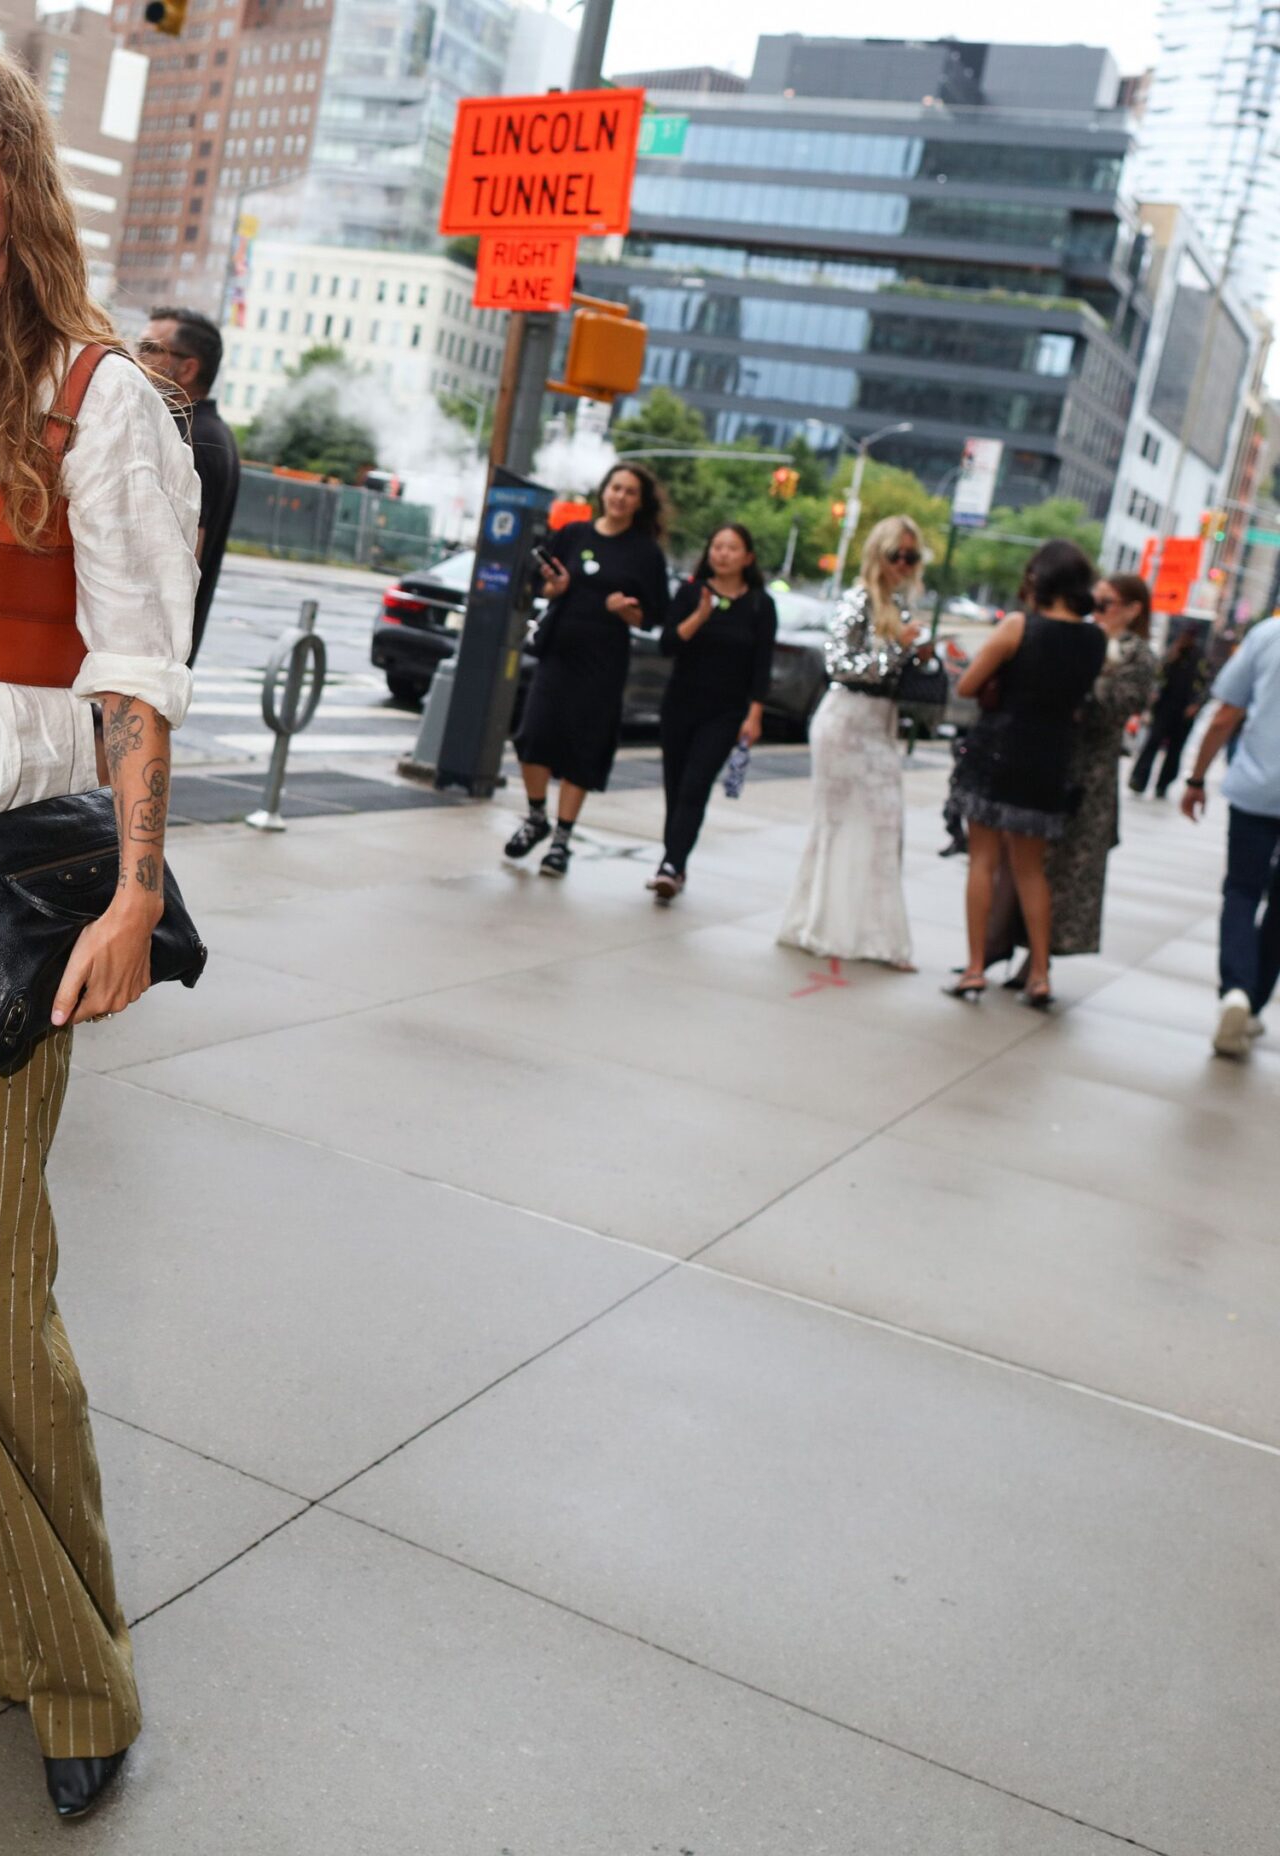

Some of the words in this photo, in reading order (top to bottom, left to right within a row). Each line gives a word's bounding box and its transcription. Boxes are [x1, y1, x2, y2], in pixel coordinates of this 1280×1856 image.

[472, 110, 619, 155] LINCOLN
[472, 174, 602, 216] TUNNEL
[492, 242, 559, 267] RIGHT
[491, 277, 553, 301] LANE
